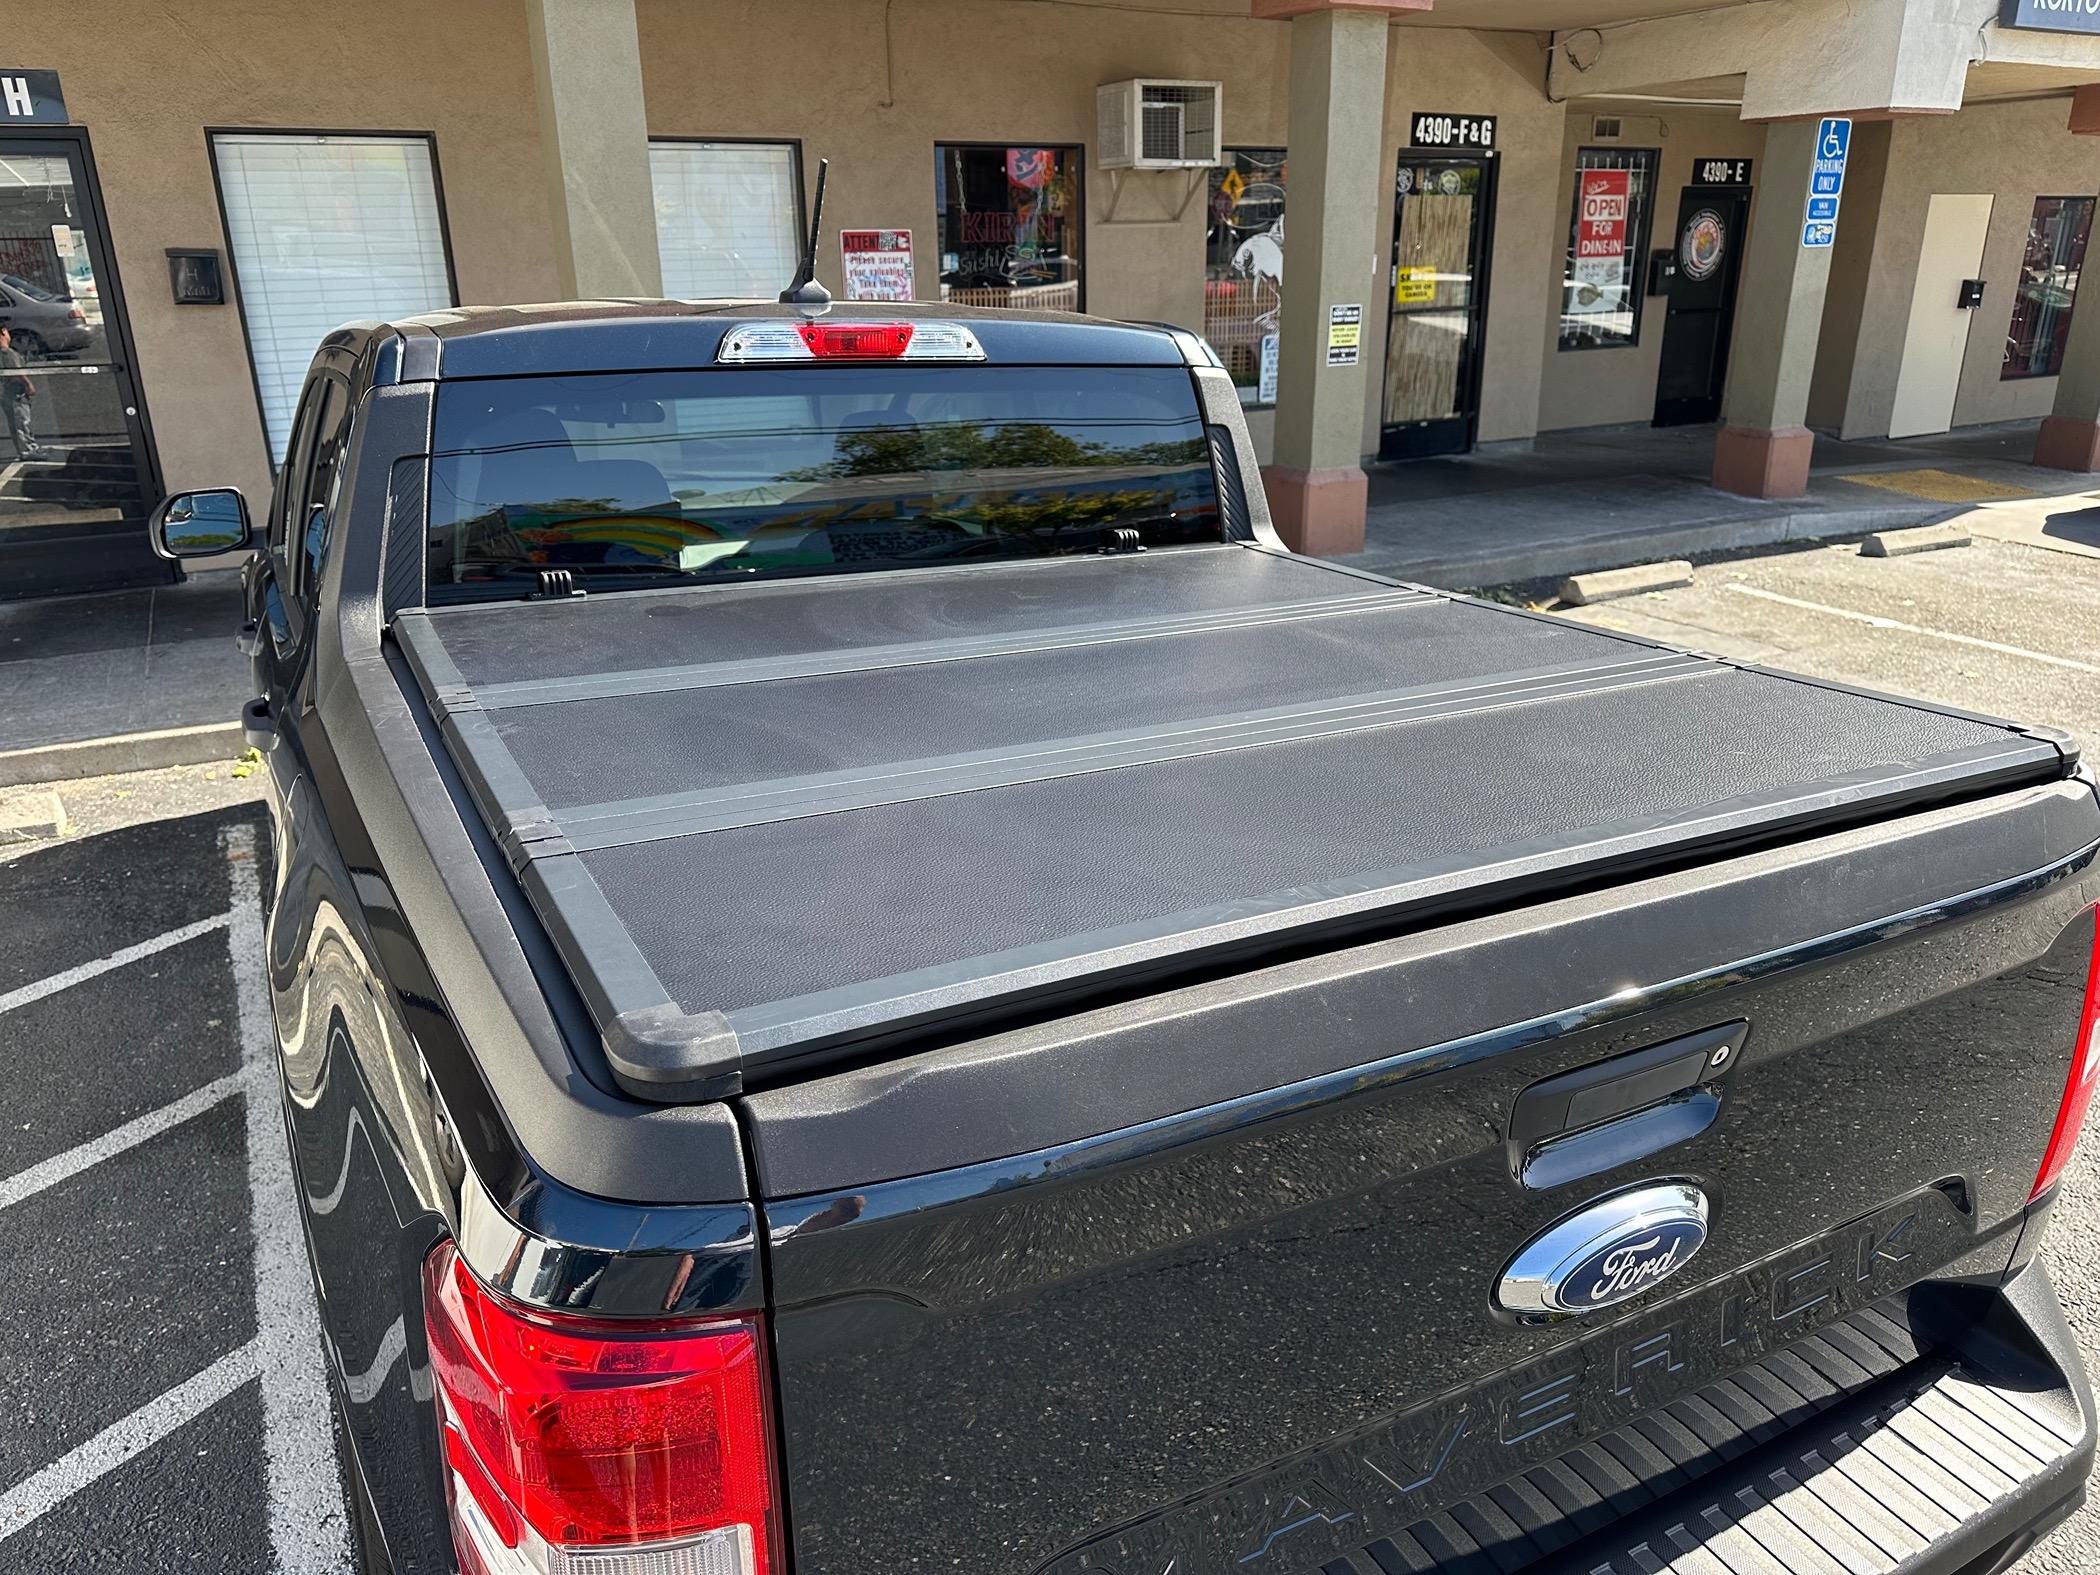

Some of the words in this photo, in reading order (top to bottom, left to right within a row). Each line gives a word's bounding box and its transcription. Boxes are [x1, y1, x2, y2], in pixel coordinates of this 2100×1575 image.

[1, 77, 34, 116] H
[1815, 159, 1843, 174] PARKING
[1817, 176, 1836, 191] ONLY
[1586, 198, 1622, 217] OPEN
[959, 211, 1058, 243] KIRN
[1592, 221, 1614, 236] FOR
[843, 234, 892, 249] ATTENT
[1581, 239, 1622, 255] DINE-IN
[1589, 1235, 1682, 1300] Ford
[1166, 1213, 1914, 1575] AVERICK
